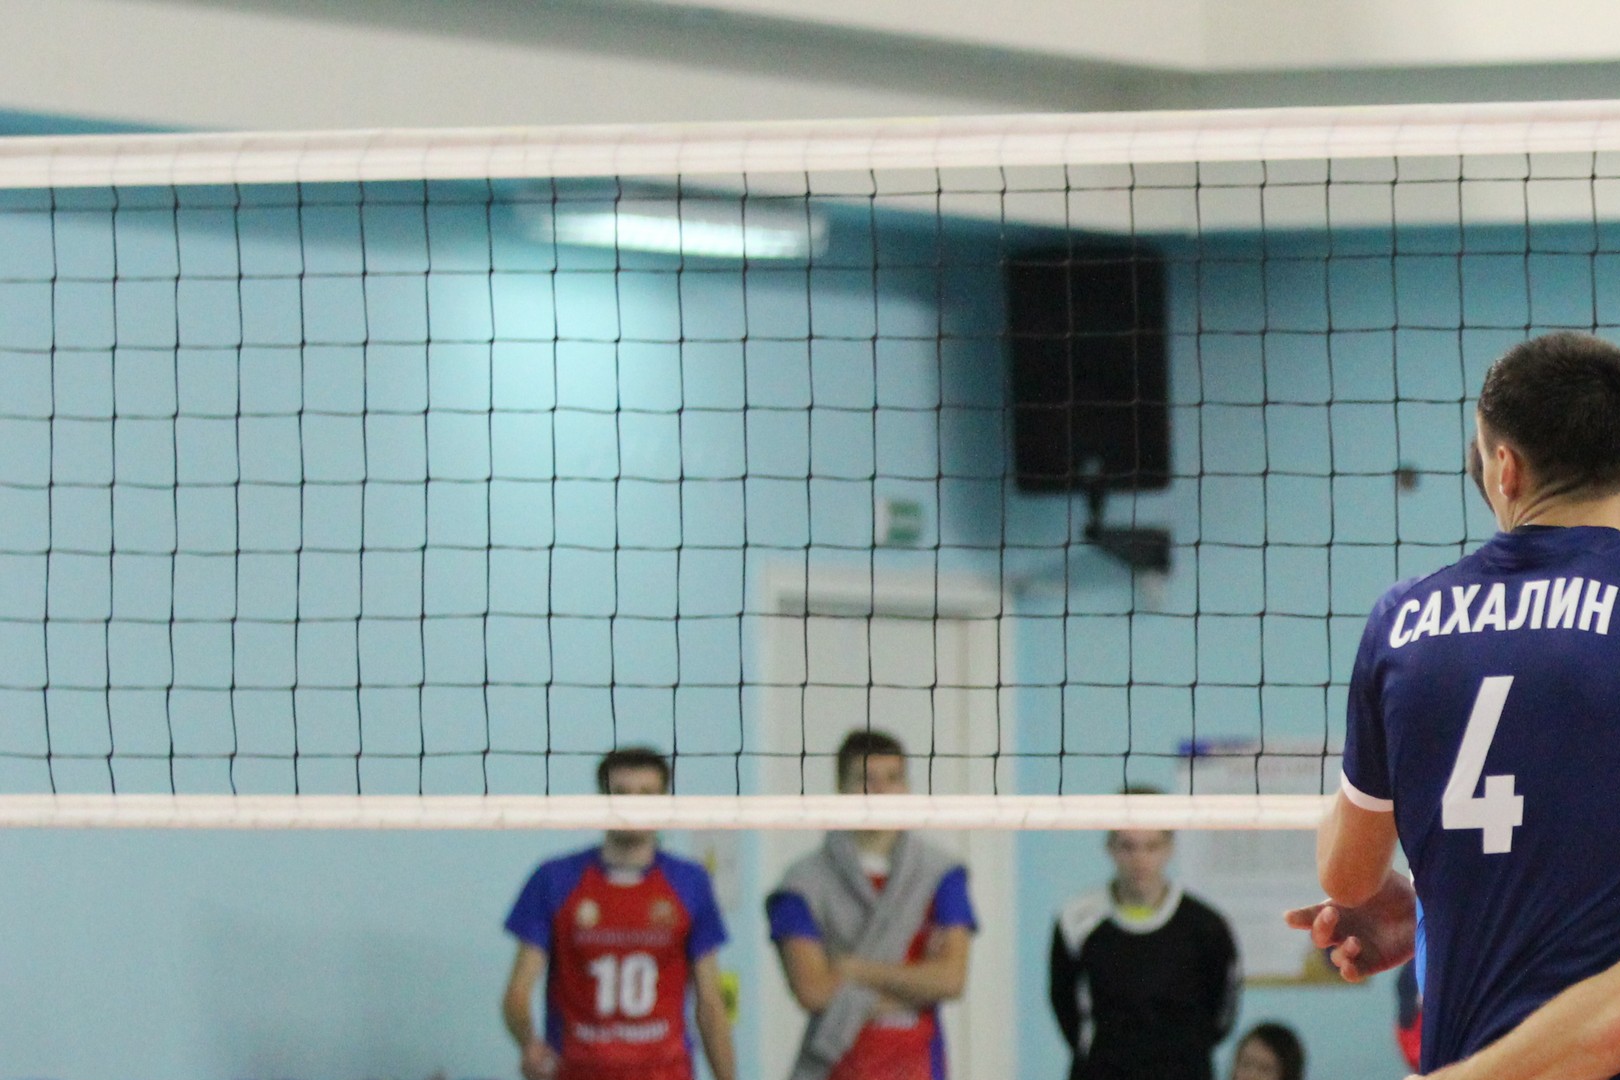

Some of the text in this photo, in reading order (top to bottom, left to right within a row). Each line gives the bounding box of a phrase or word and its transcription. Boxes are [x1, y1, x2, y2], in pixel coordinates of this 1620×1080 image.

[1389, 577, 1619, 648] САХАЛИН
[1441, 675, 1524, 854] 4
[589, 953, 658, 1018] 10
